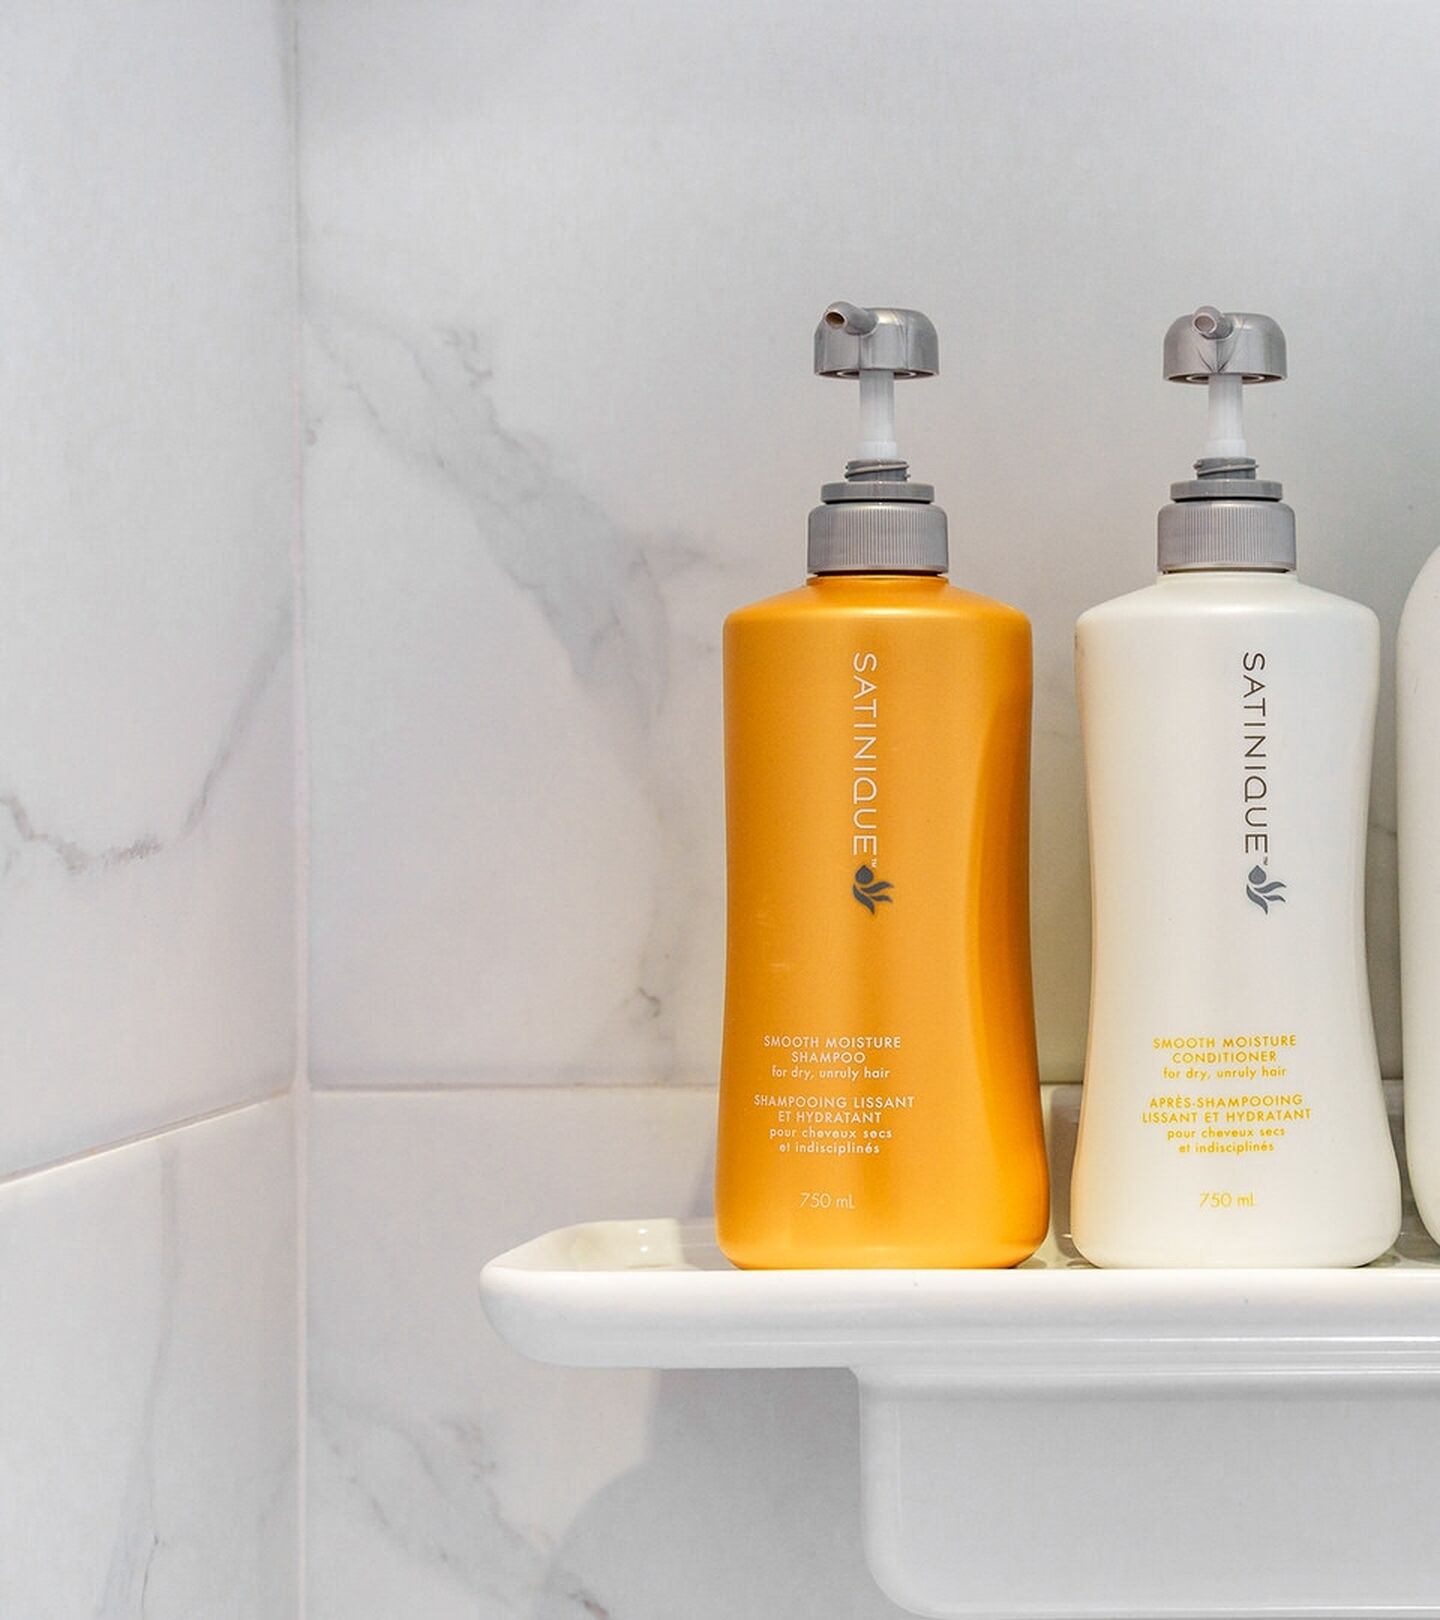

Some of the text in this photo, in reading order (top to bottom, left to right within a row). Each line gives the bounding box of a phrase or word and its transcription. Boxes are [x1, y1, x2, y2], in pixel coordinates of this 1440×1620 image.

[764, 1035, 901, 1049] SMOOTH MOISTURE
[1153, 1035, 1297, 1049] SMOOTH MOISTURE
[791, 1051, 866, 1063] SHAMPOO
[1172, 1050, 1277, 1063] CONDITIONER
[772, 1065, 891, 1081] for dry, unruly hair
[1163, 1066, 1286, 1080] for dry, unruly hair
[754, 1094, 915, 1108] SHAMPOOING LISSANT
[1149, 1094, 1303, 1108] APRÈS-SHAMPOOING
[778, 1111, 882, 1124] ET HYDRATANT
[1142, 1108, 1312, 1123] LISSANT ET HYDRATANT
[769, 1126, 892, 1139] pour cheveux secs
[1167, 1127, 1285, 1140] pour cheveux secs
[779, 1141, 880, 1156] et indisciplinés
[1179, 1140, 1275, 1155] et indisciplinés
[800, 1192, 831, 1209] 750
[1199, 1192, 1232, 1209] 750
